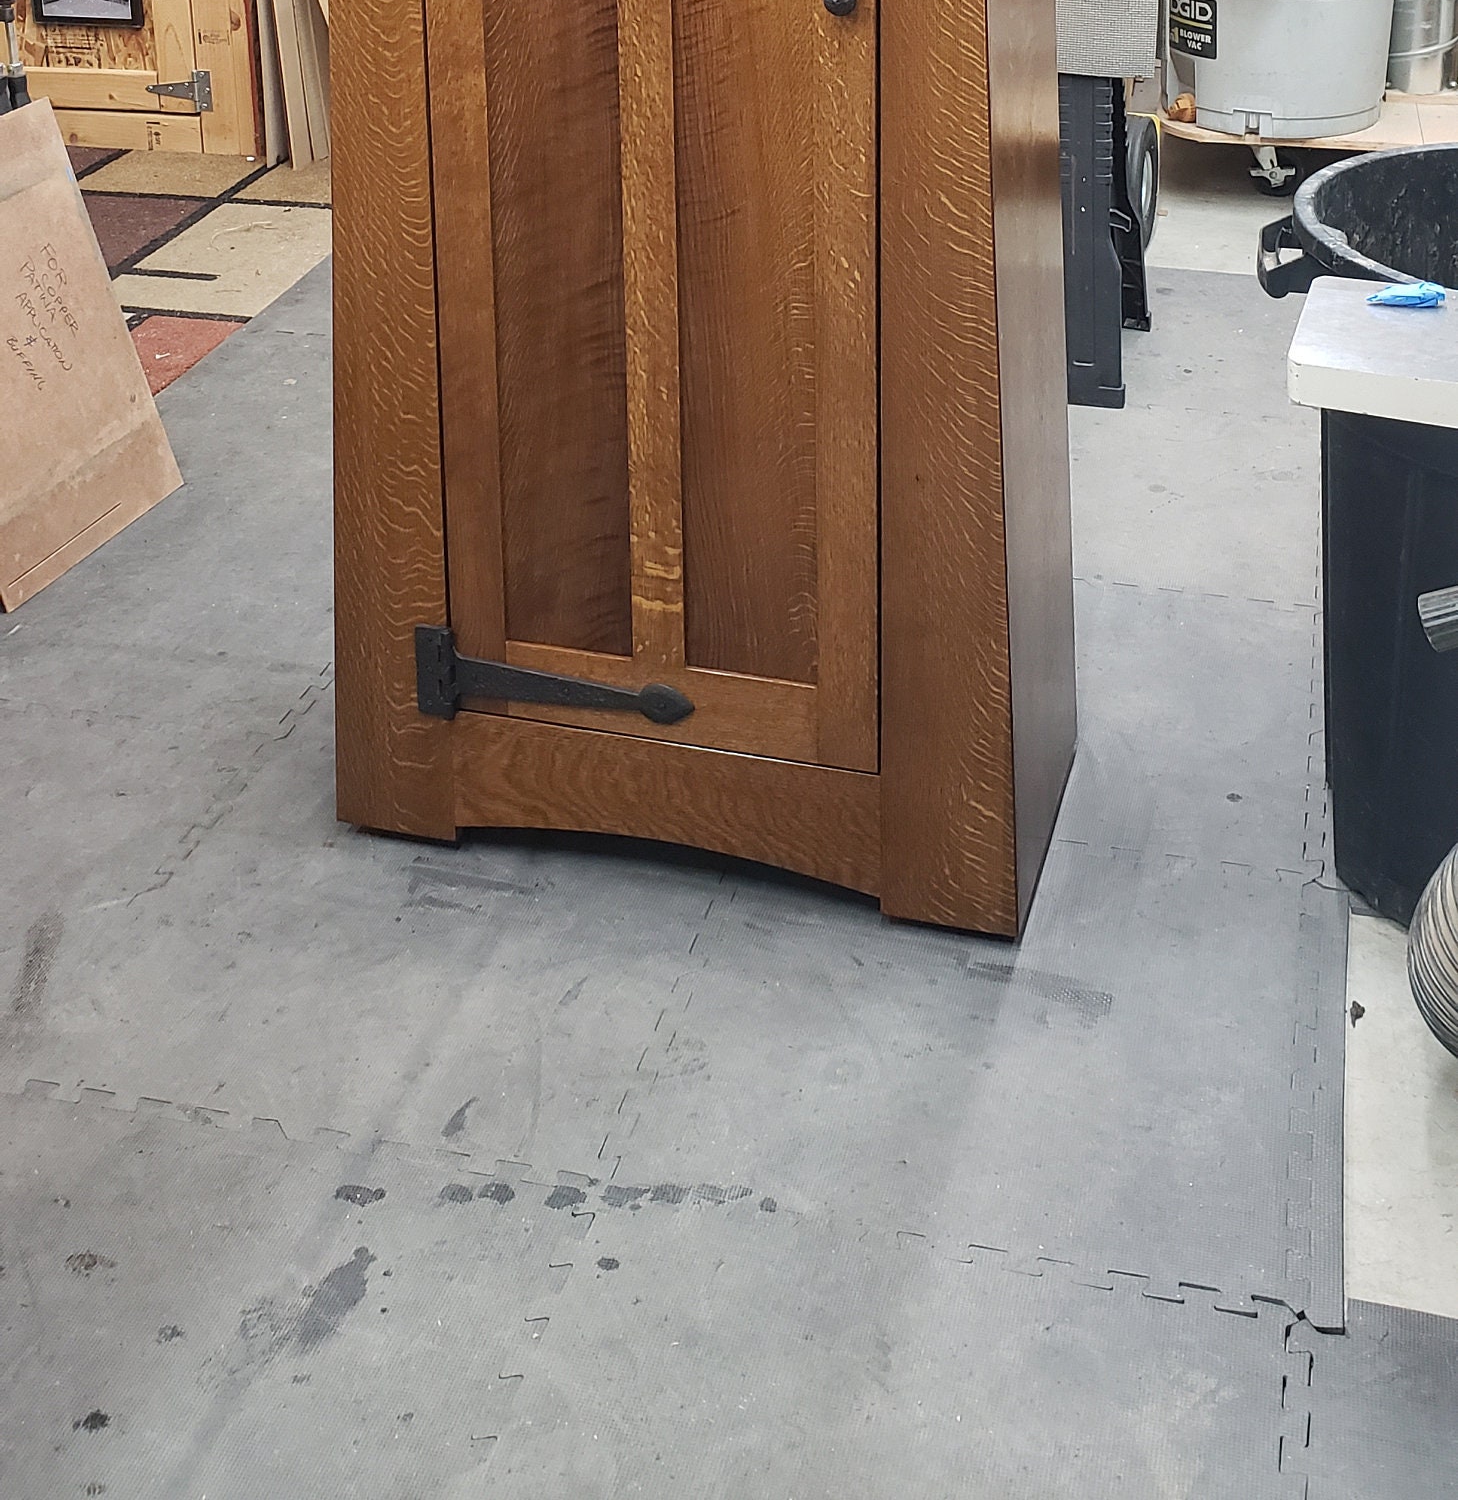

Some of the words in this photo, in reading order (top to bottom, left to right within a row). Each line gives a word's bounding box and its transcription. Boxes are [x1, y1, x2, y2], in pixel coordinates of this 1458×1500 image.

[1180, 29, 1211, 44] BLOWER
[1187, 40, 1202, 50] VAC
[20, 255, 56, 322] PATINA
[40, 243, 67, 289] FOR
[42, 274, 78, 338] COPPER
